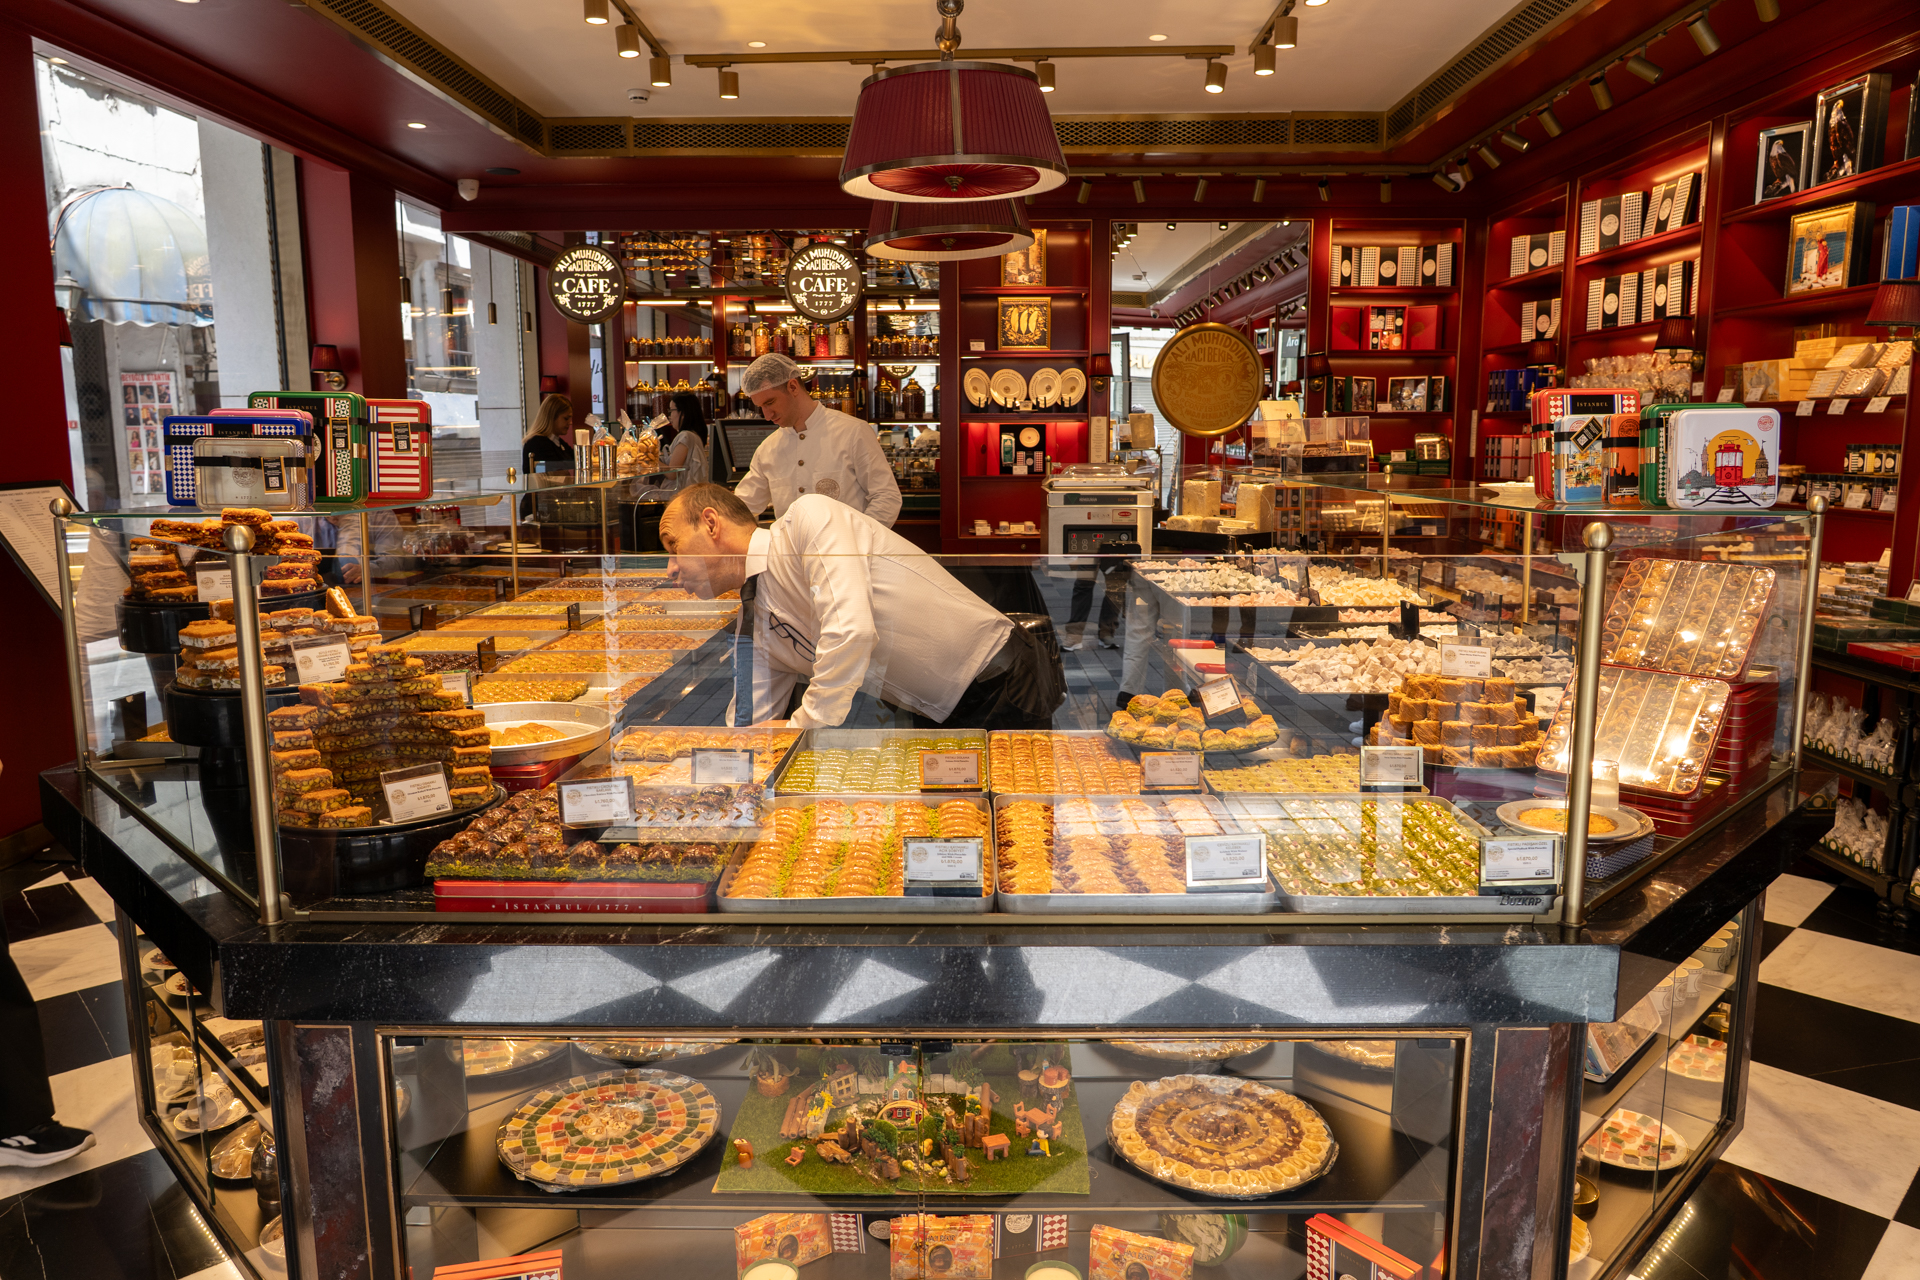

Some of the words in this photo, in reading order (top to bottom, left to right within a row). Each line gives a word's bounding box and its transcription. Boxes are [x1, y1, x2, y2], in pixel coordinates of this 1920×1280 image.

[562, 278, 611, 294] CAFE
[799, 276, 848, 292] CAFE
[1185, 347, 1206, 362] HACI
[505, 902, 582, 910] İSTANBUL
